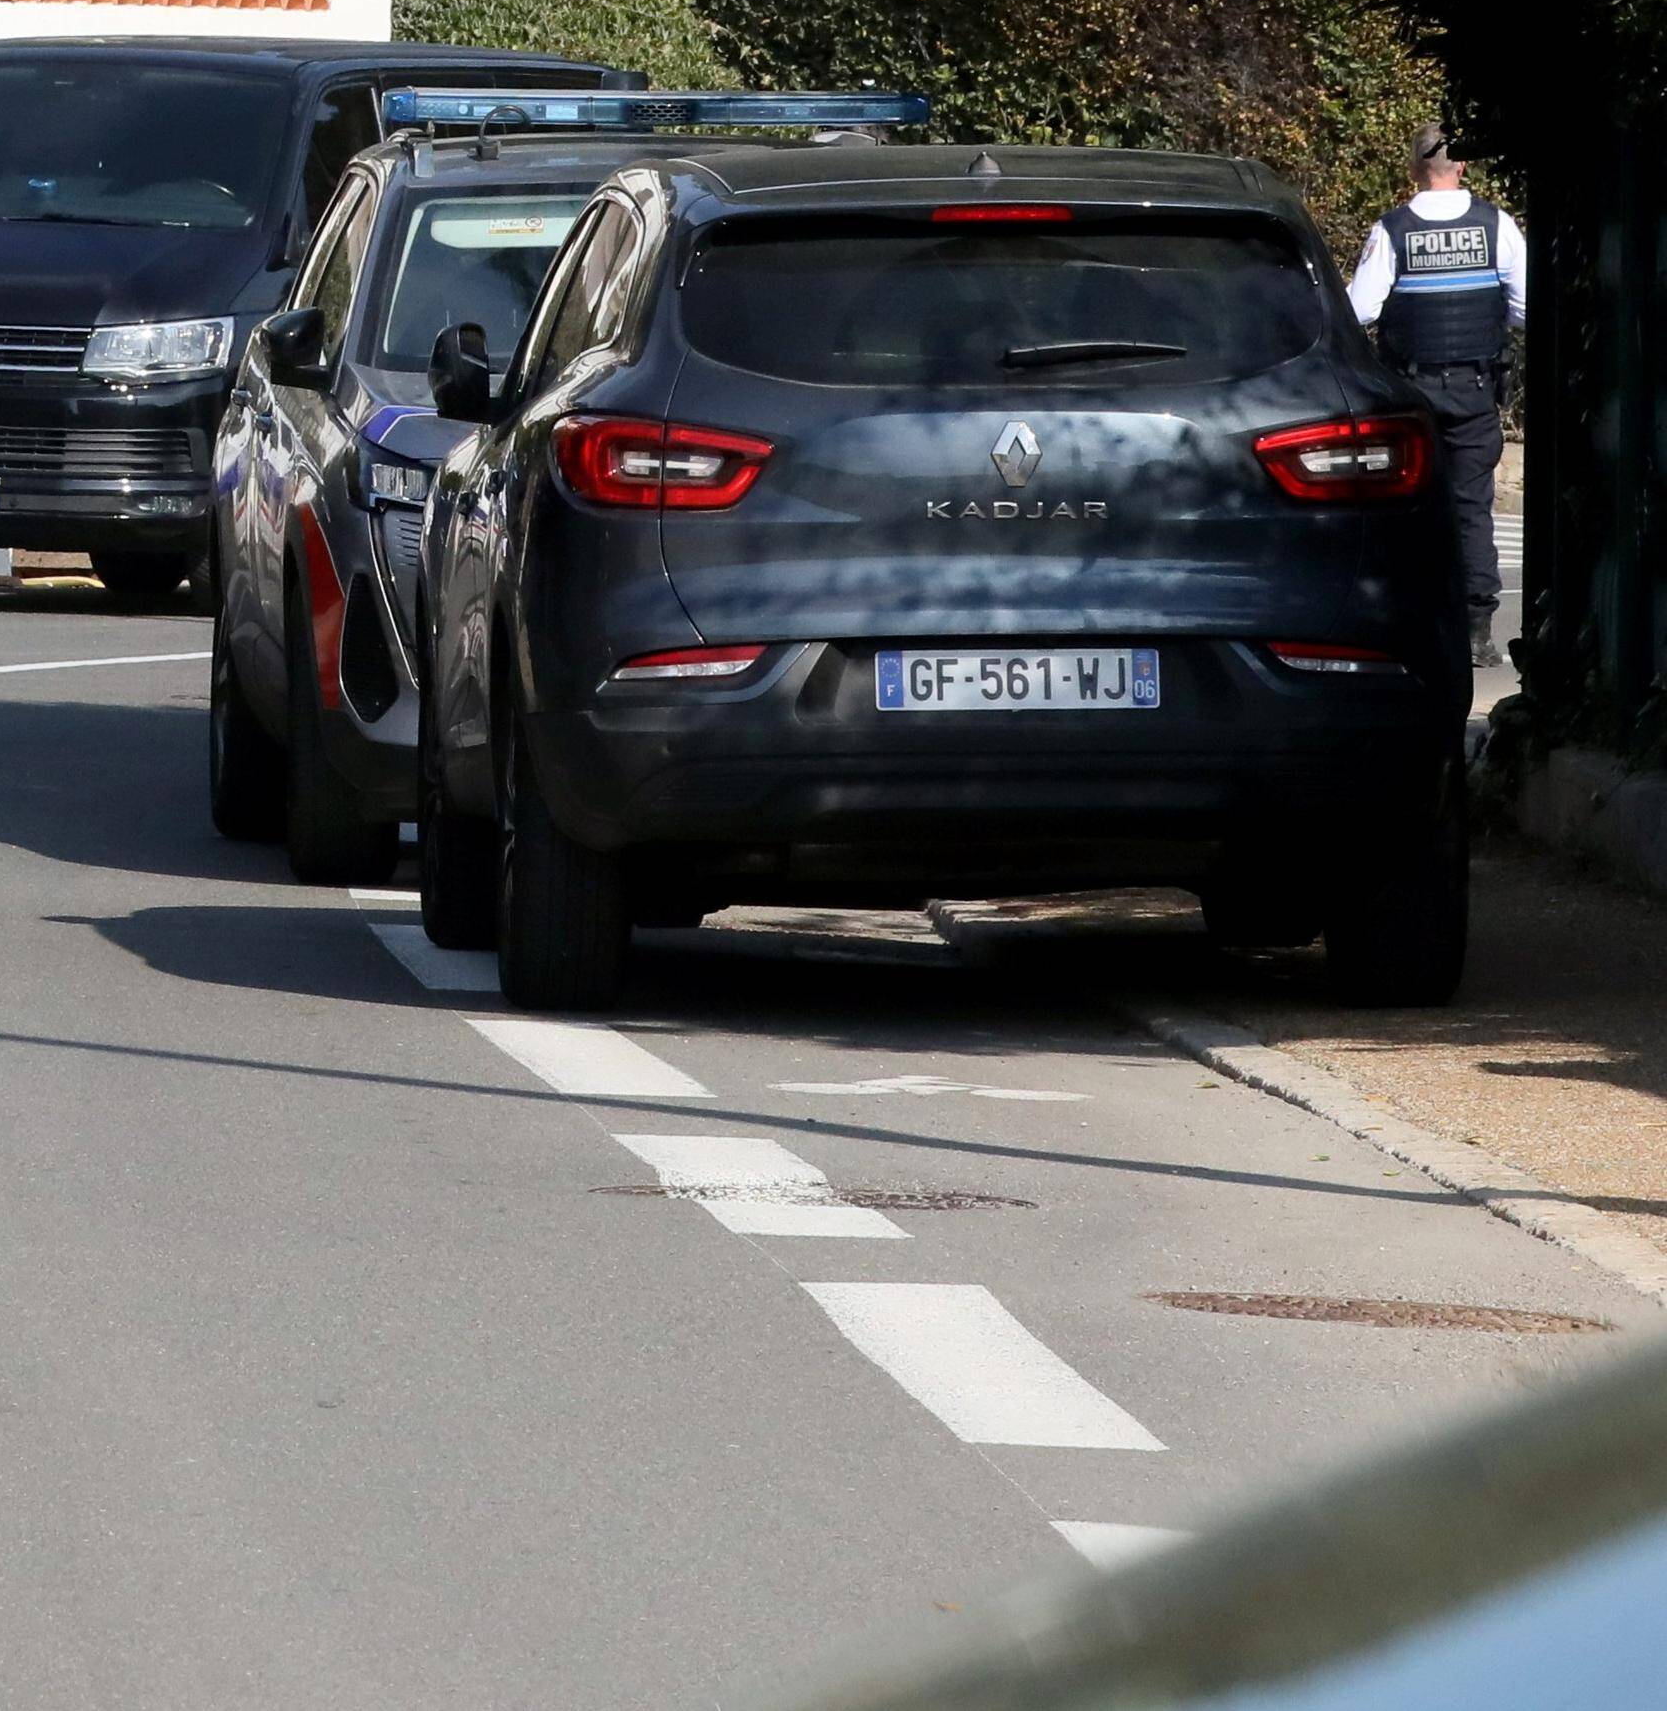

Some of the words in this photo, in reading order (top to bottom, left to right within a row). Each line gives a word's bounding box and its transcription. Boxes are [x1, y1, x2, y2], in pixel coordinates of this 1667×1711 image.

[1410, 230, 1483, 254] POLICE
[1412, 251, 1484, 268] MUNICIPALE
[926, 500, 1109, 520] KADJAR
[909, 657, 1126, 701] GF-561-WJ
[1133, 679, 1156, 699] 06
[886, 684, 896, 697] F
